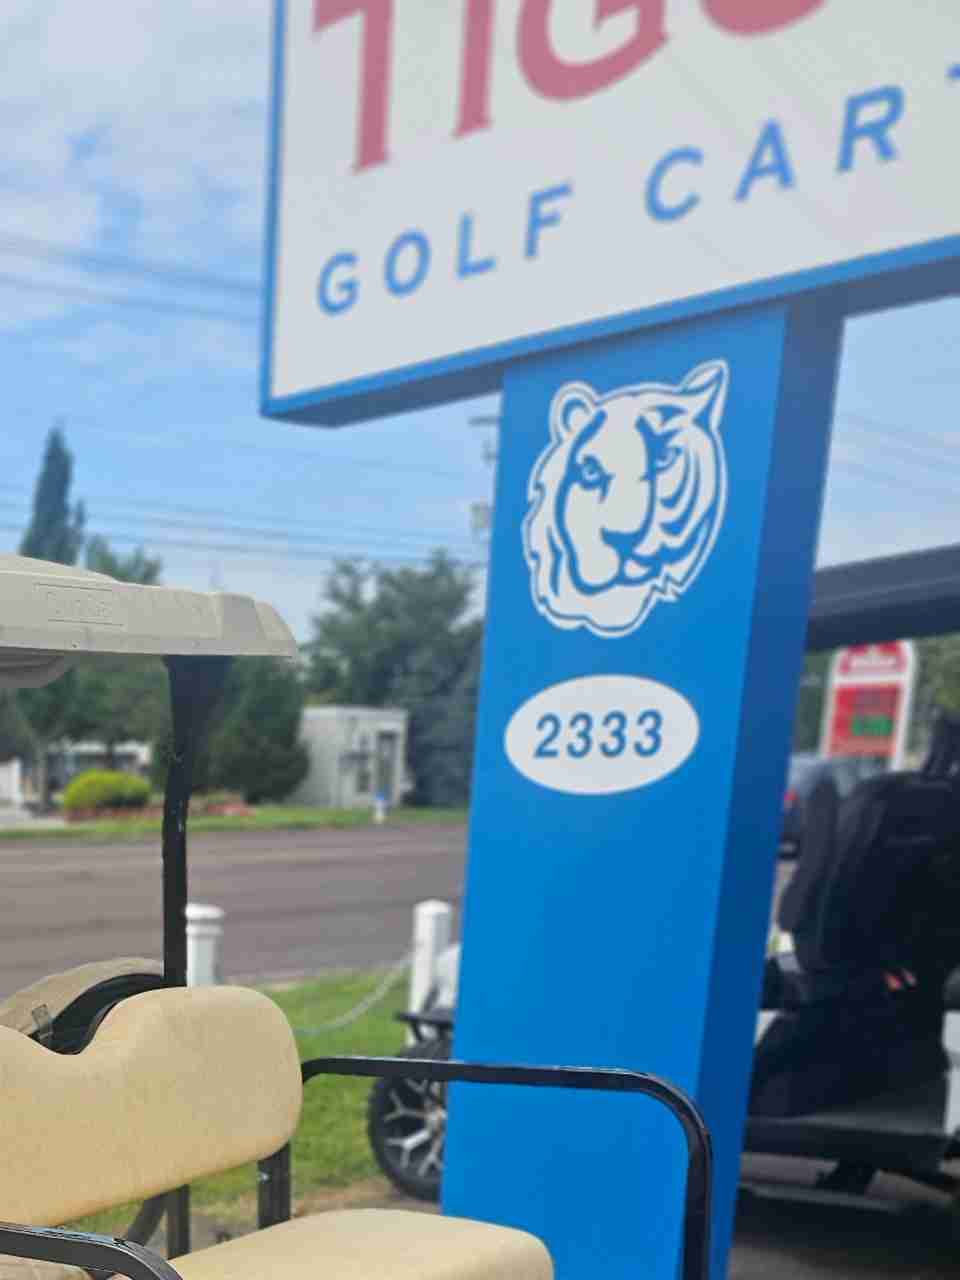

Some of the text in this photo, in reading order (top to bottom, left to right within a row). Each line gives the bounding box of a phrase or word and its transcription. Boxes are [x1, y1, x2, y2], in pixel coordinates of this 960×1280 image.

[316, 64, 960, 315] GOLF CAR
[533, 709, 664, 759] 2333
